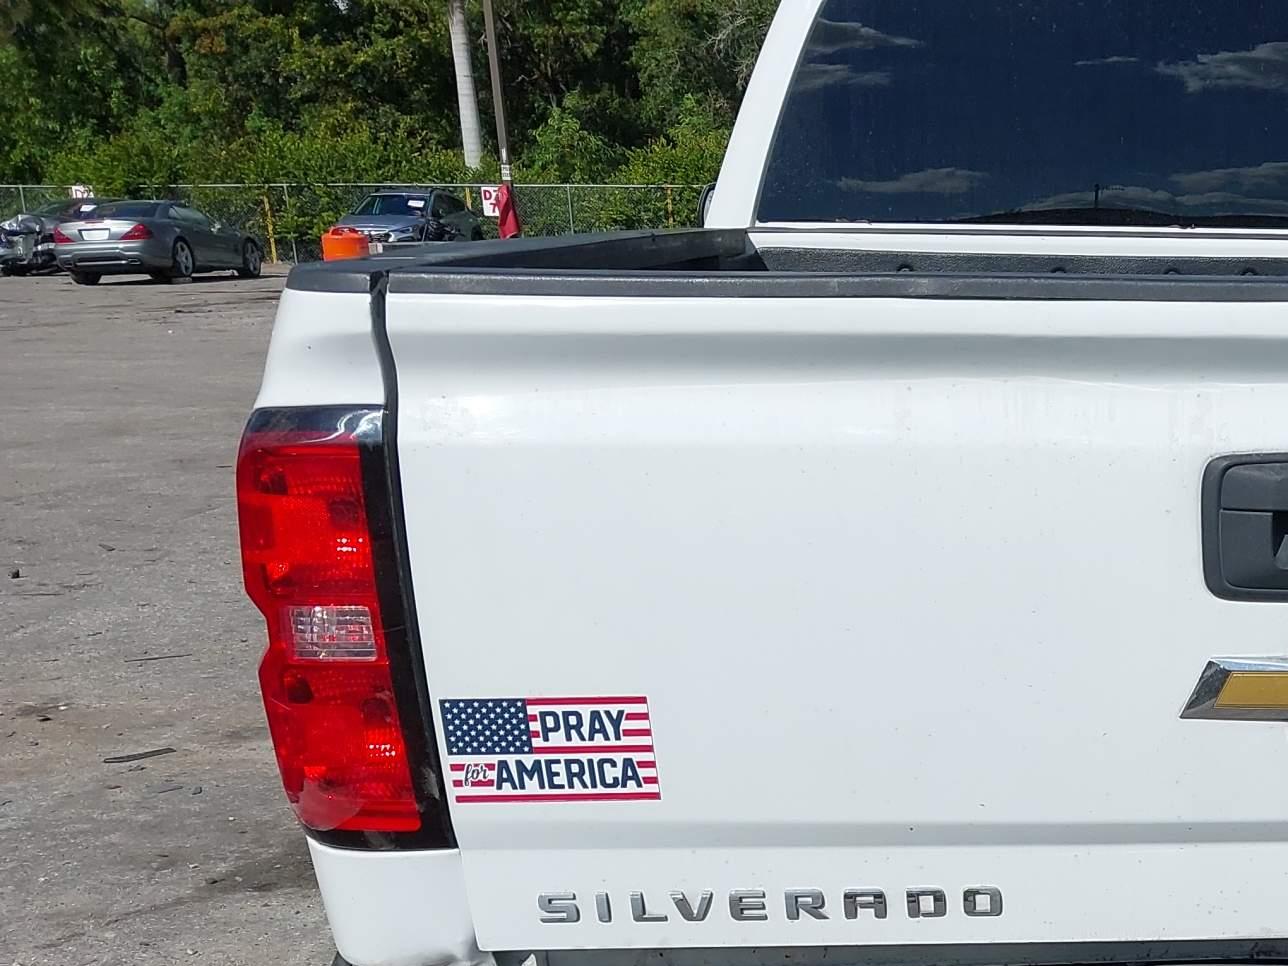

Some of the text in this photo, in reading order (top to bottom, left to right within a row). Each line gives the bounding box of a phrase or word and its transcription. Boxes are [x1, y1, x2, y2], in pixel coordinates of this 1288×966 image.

[539, 710, 625, 742] PRAY
[464, 757, 643, 790] for AMERICA
[537, 887, 1004, 923] SILVERADO
